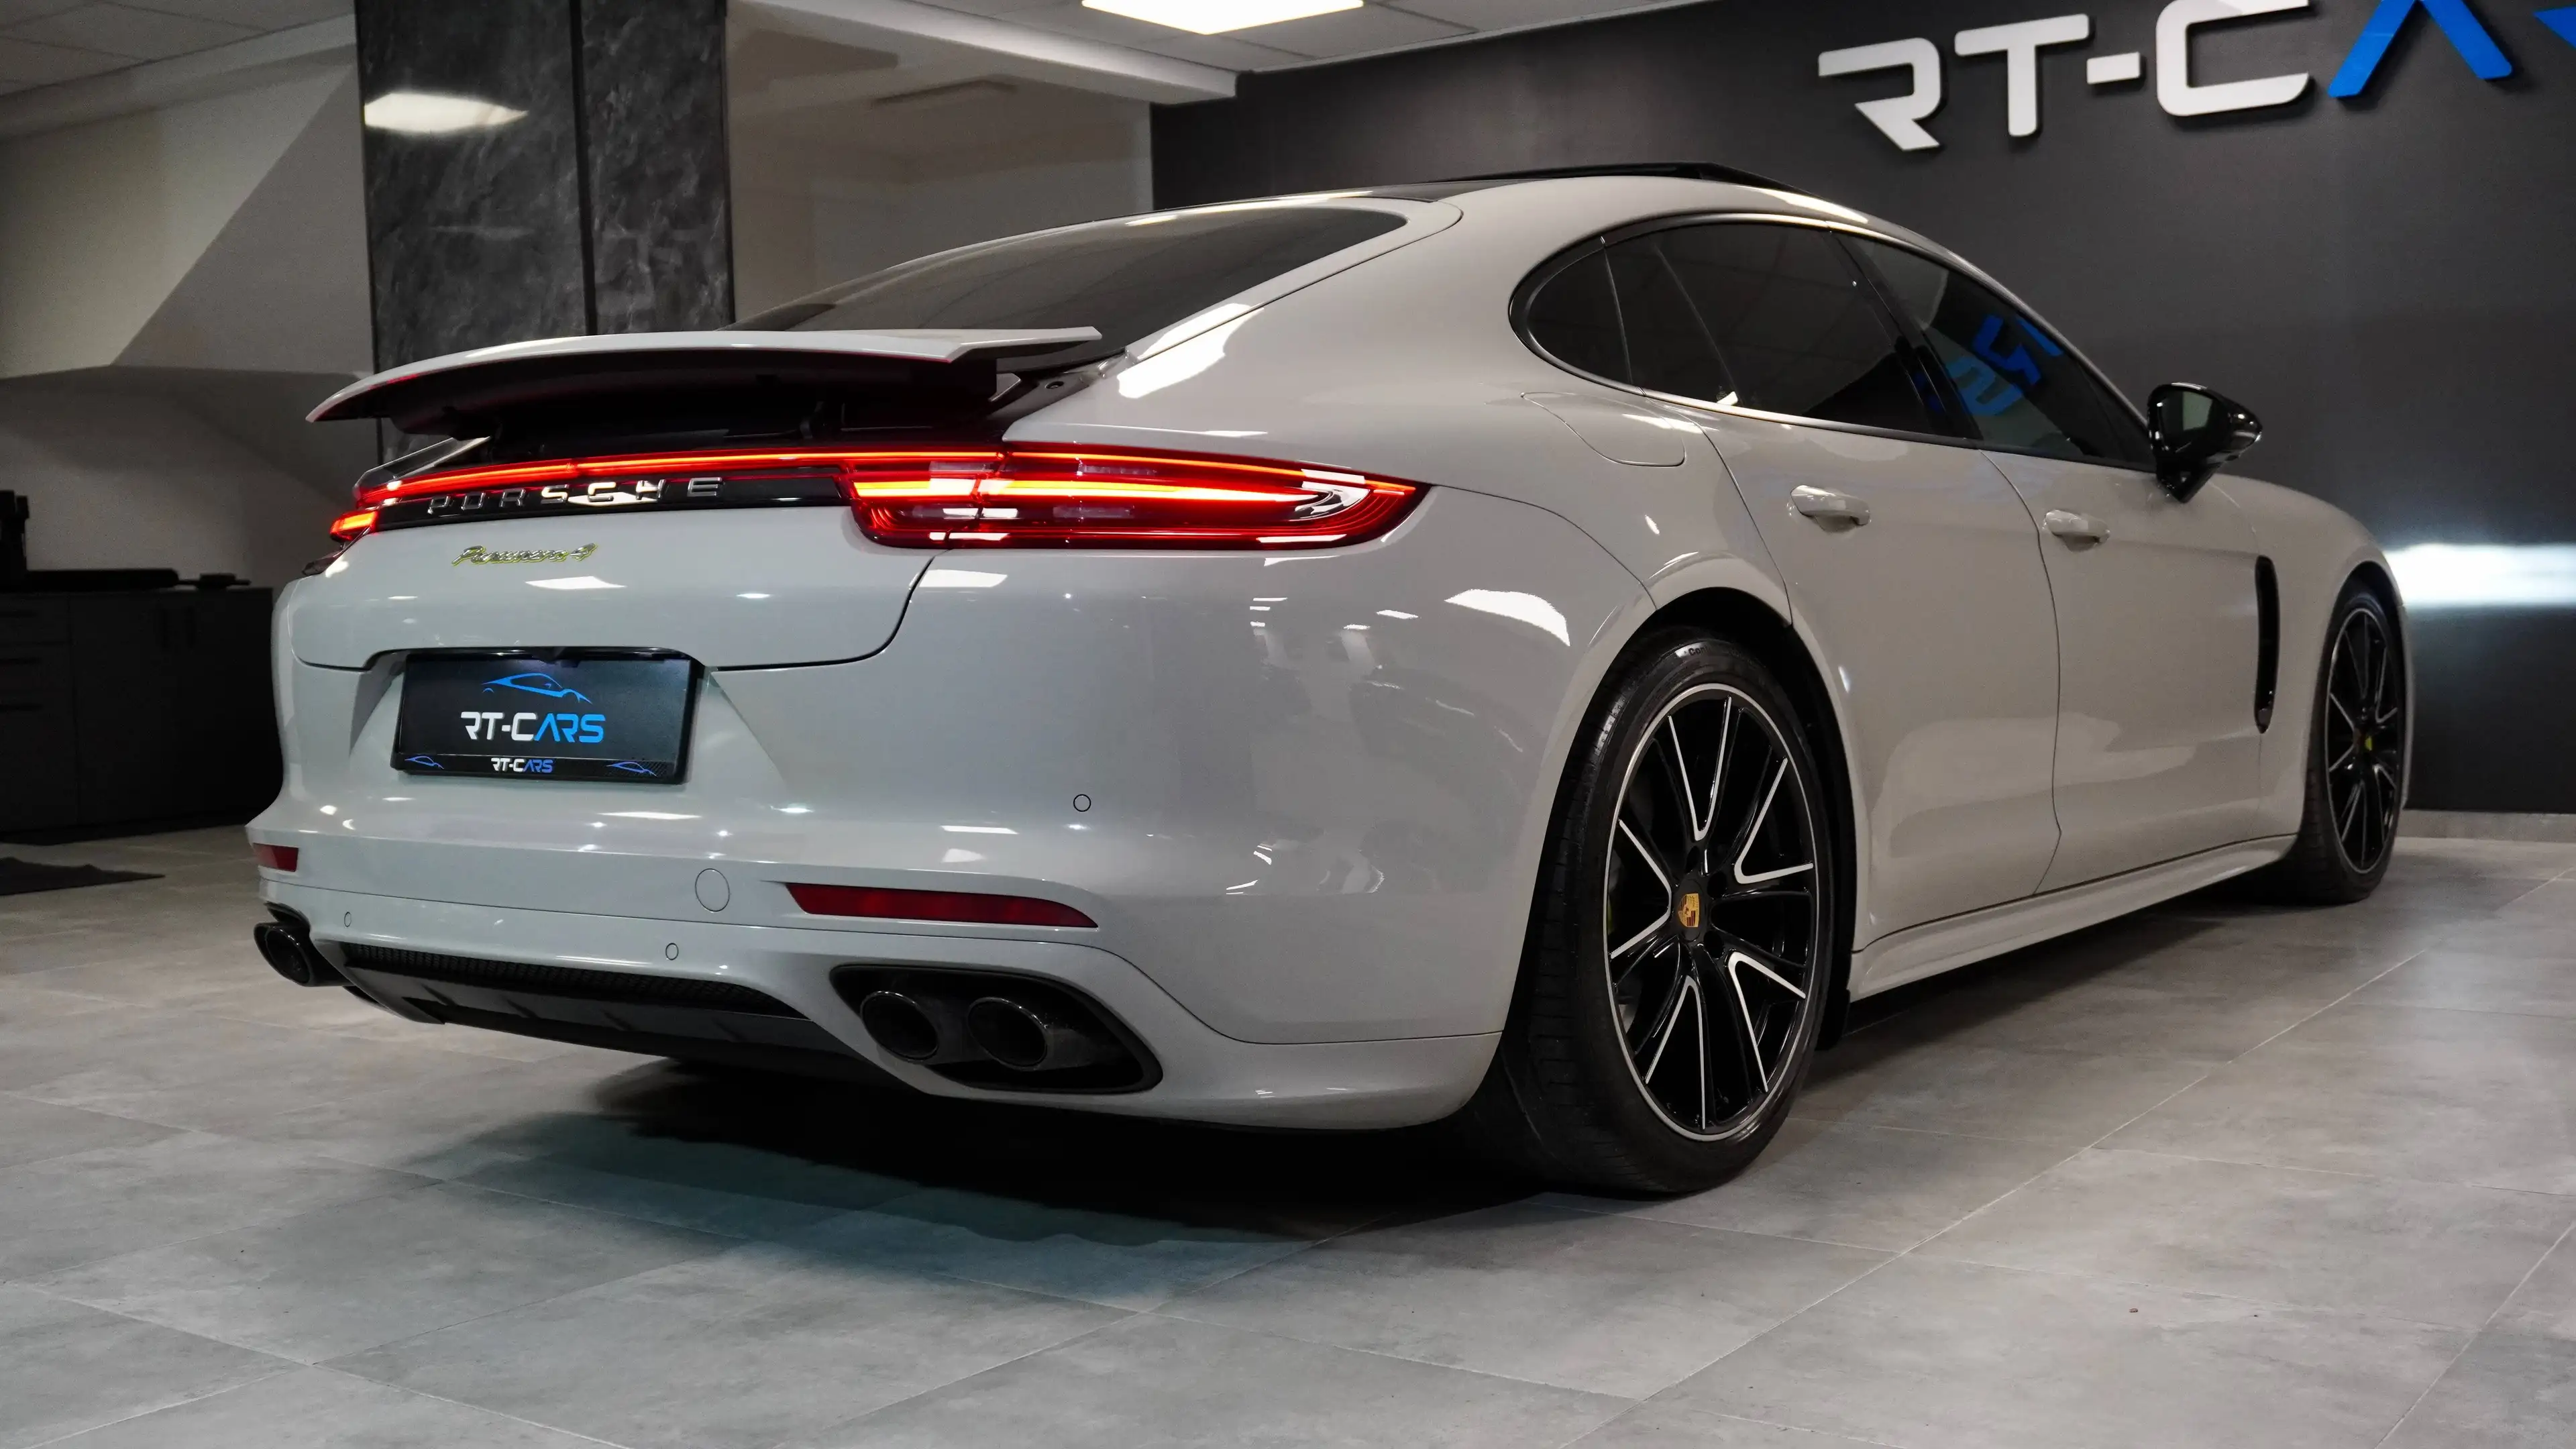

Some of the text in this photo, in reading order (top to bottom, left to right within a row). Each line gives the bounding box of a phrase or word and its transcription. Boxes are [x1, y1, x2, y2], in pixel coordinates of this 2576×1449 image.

[1817, 0, 2576, 152] RT-CA
[427, 477, 723, 515] PORSCHE
[570, 543, 598, 561] 4
[460, 711, 606, 743] RT-CARS
[491, 757, 555, 773] RT-CARS
